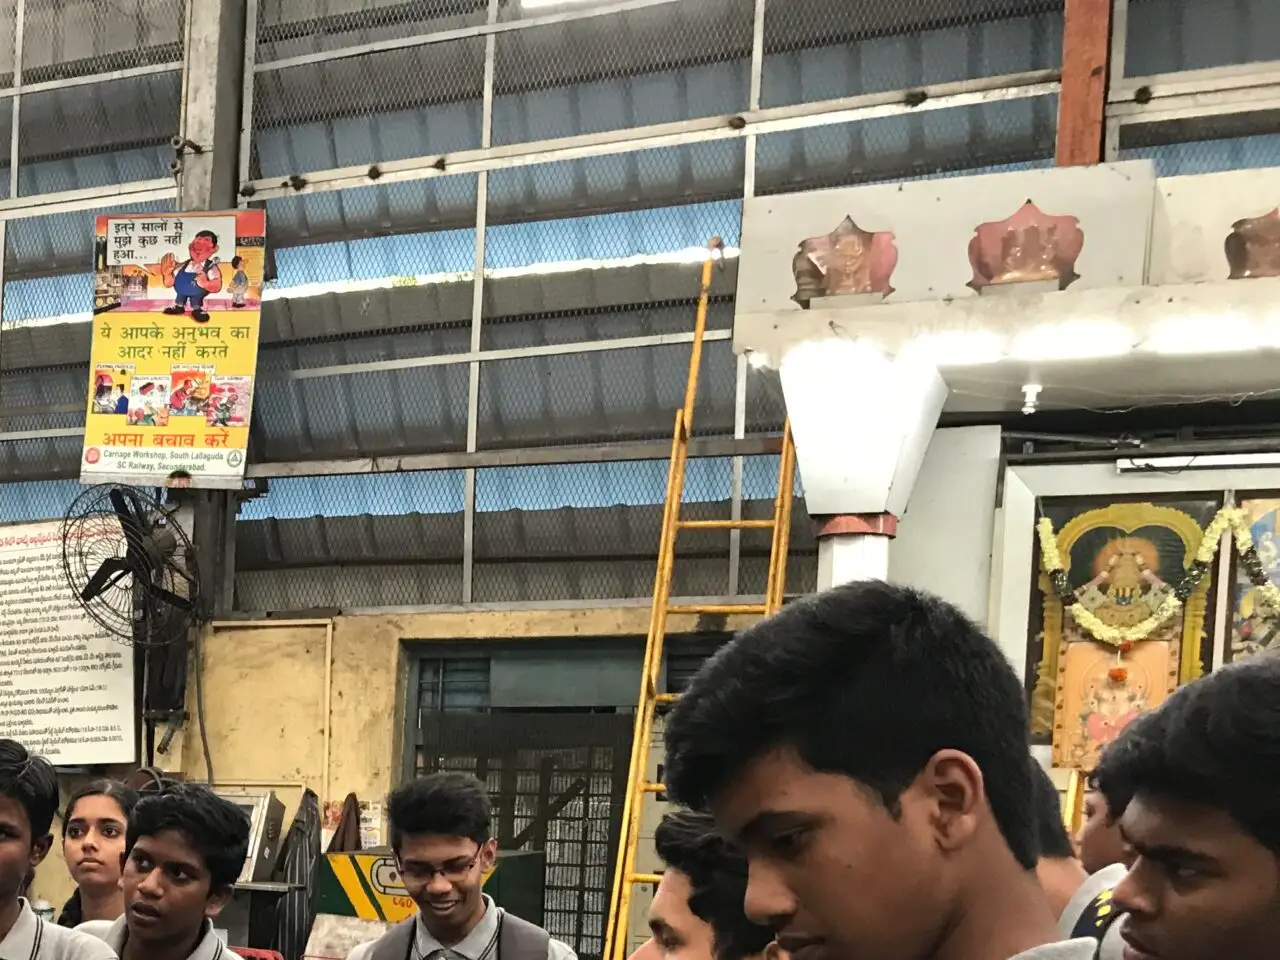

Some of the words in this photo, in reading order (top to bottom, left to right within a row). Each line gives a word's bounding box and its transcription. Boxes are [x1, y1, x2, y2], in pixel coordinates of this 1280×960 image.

[141, 219, 168, 231] सालों
[174, 219, 183, 231] से
[138, 236, 158, 248] कुछ
[164, 231, 183, 245] नहीं
[100, 322, 112, 339] ये
[120, 322, 164, 339] आपके
[173, 326, 221, 346] अनुभव
[230, 326, 250, 339] का
[119, 345, 153, 359] आदर
[160, 341, 186, 359] नहीं
[195, 340, 228, 359] करते
[102, 432, 144, 447] अपना
[153, 432, 195, 448] बचाव
[204, 428, 229, 447] करें
[170, 451, 189, 459] South
